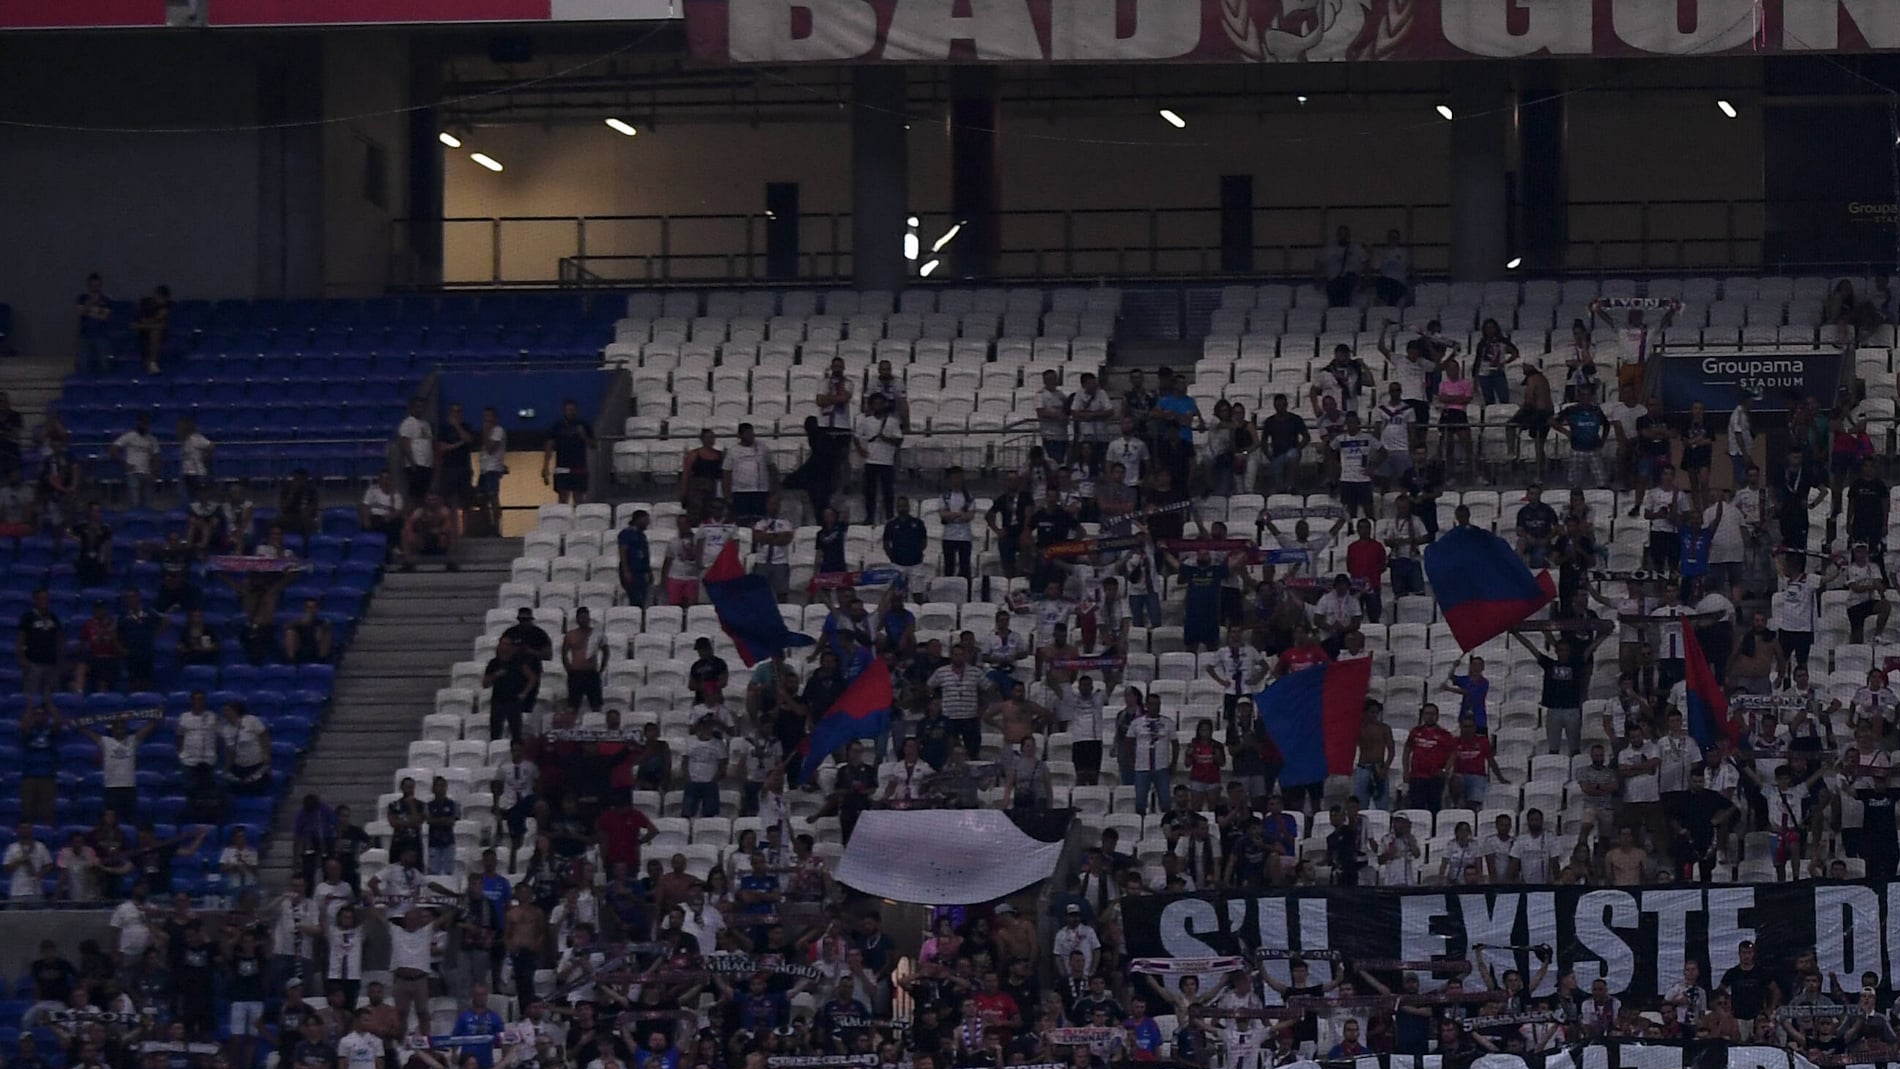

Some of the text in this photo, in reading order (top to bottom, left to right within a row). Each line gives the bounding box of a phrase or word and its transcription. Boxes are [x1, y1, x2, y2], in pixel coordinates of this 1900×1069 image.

[1702, 359, 1803, 376] Groupama
[1739, 376, 1804, 388] STADIUM
[1400, 889, 1757, 999] EXISTE
